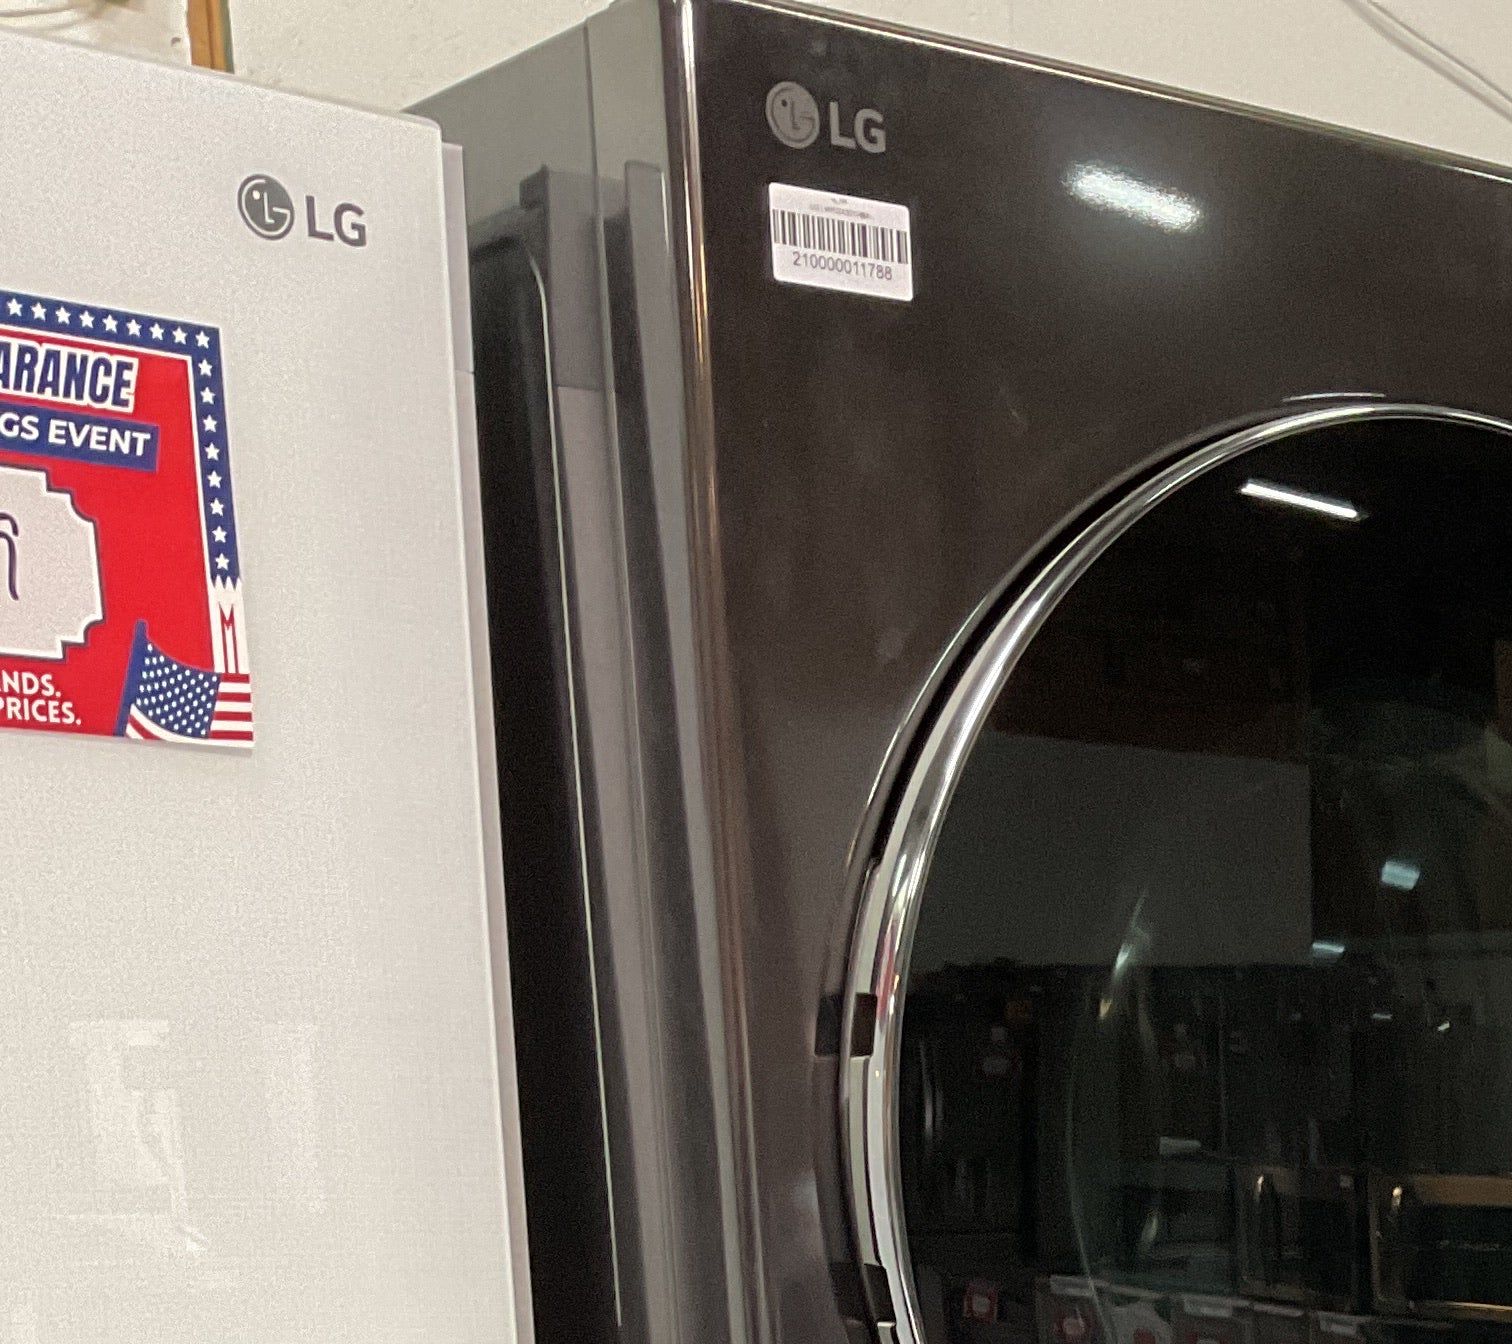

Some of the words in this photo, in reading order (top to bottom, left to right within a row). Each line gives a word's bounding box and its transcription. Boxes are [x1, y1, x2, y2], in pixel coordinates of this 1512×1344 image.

[829, 101, 887, 153] LG
[306, 195, 367, 247] LG
[48, 419, 151, 457] EVENT
[0, 670, 61, 698] NDS.
